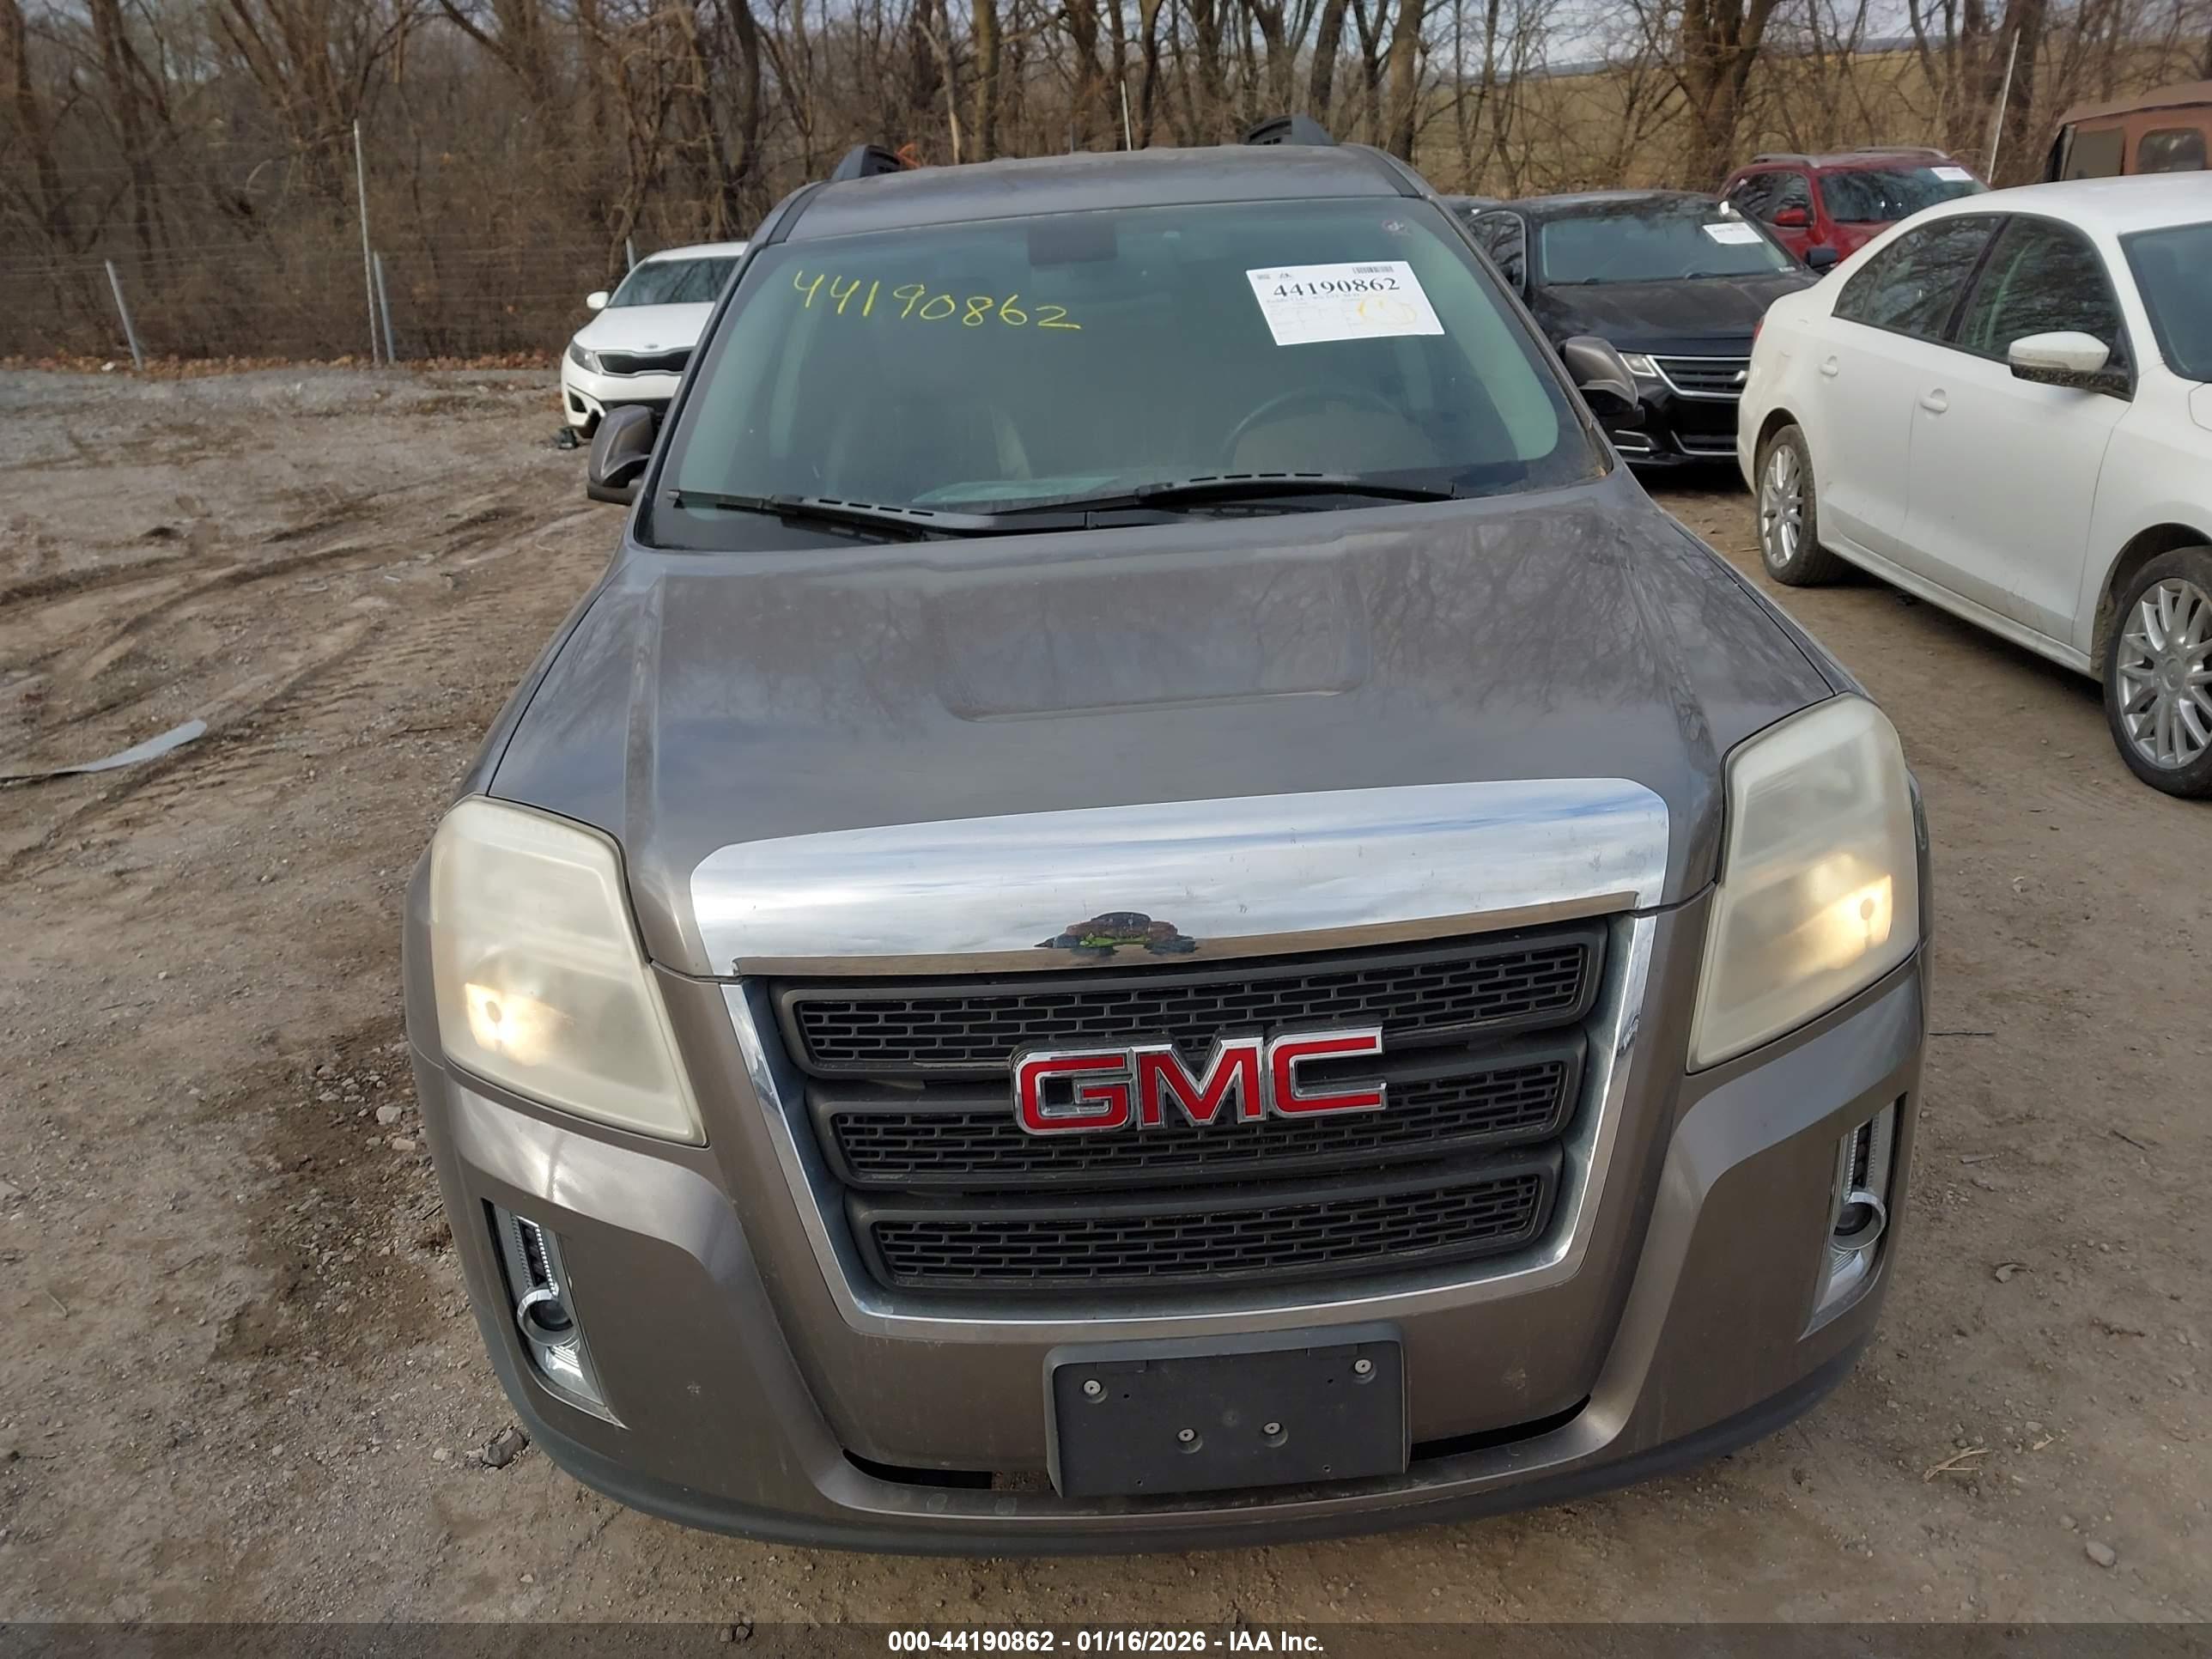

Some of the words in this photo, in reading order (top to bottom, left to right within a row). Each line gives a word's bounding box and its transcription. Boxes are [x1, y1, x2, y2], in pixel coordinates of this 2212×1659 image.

[793, 270, 1083, 330] 44190862
[1273, 277, 1401, 297] 44190862
[1012, 1026, 1388, 1135] GMC
